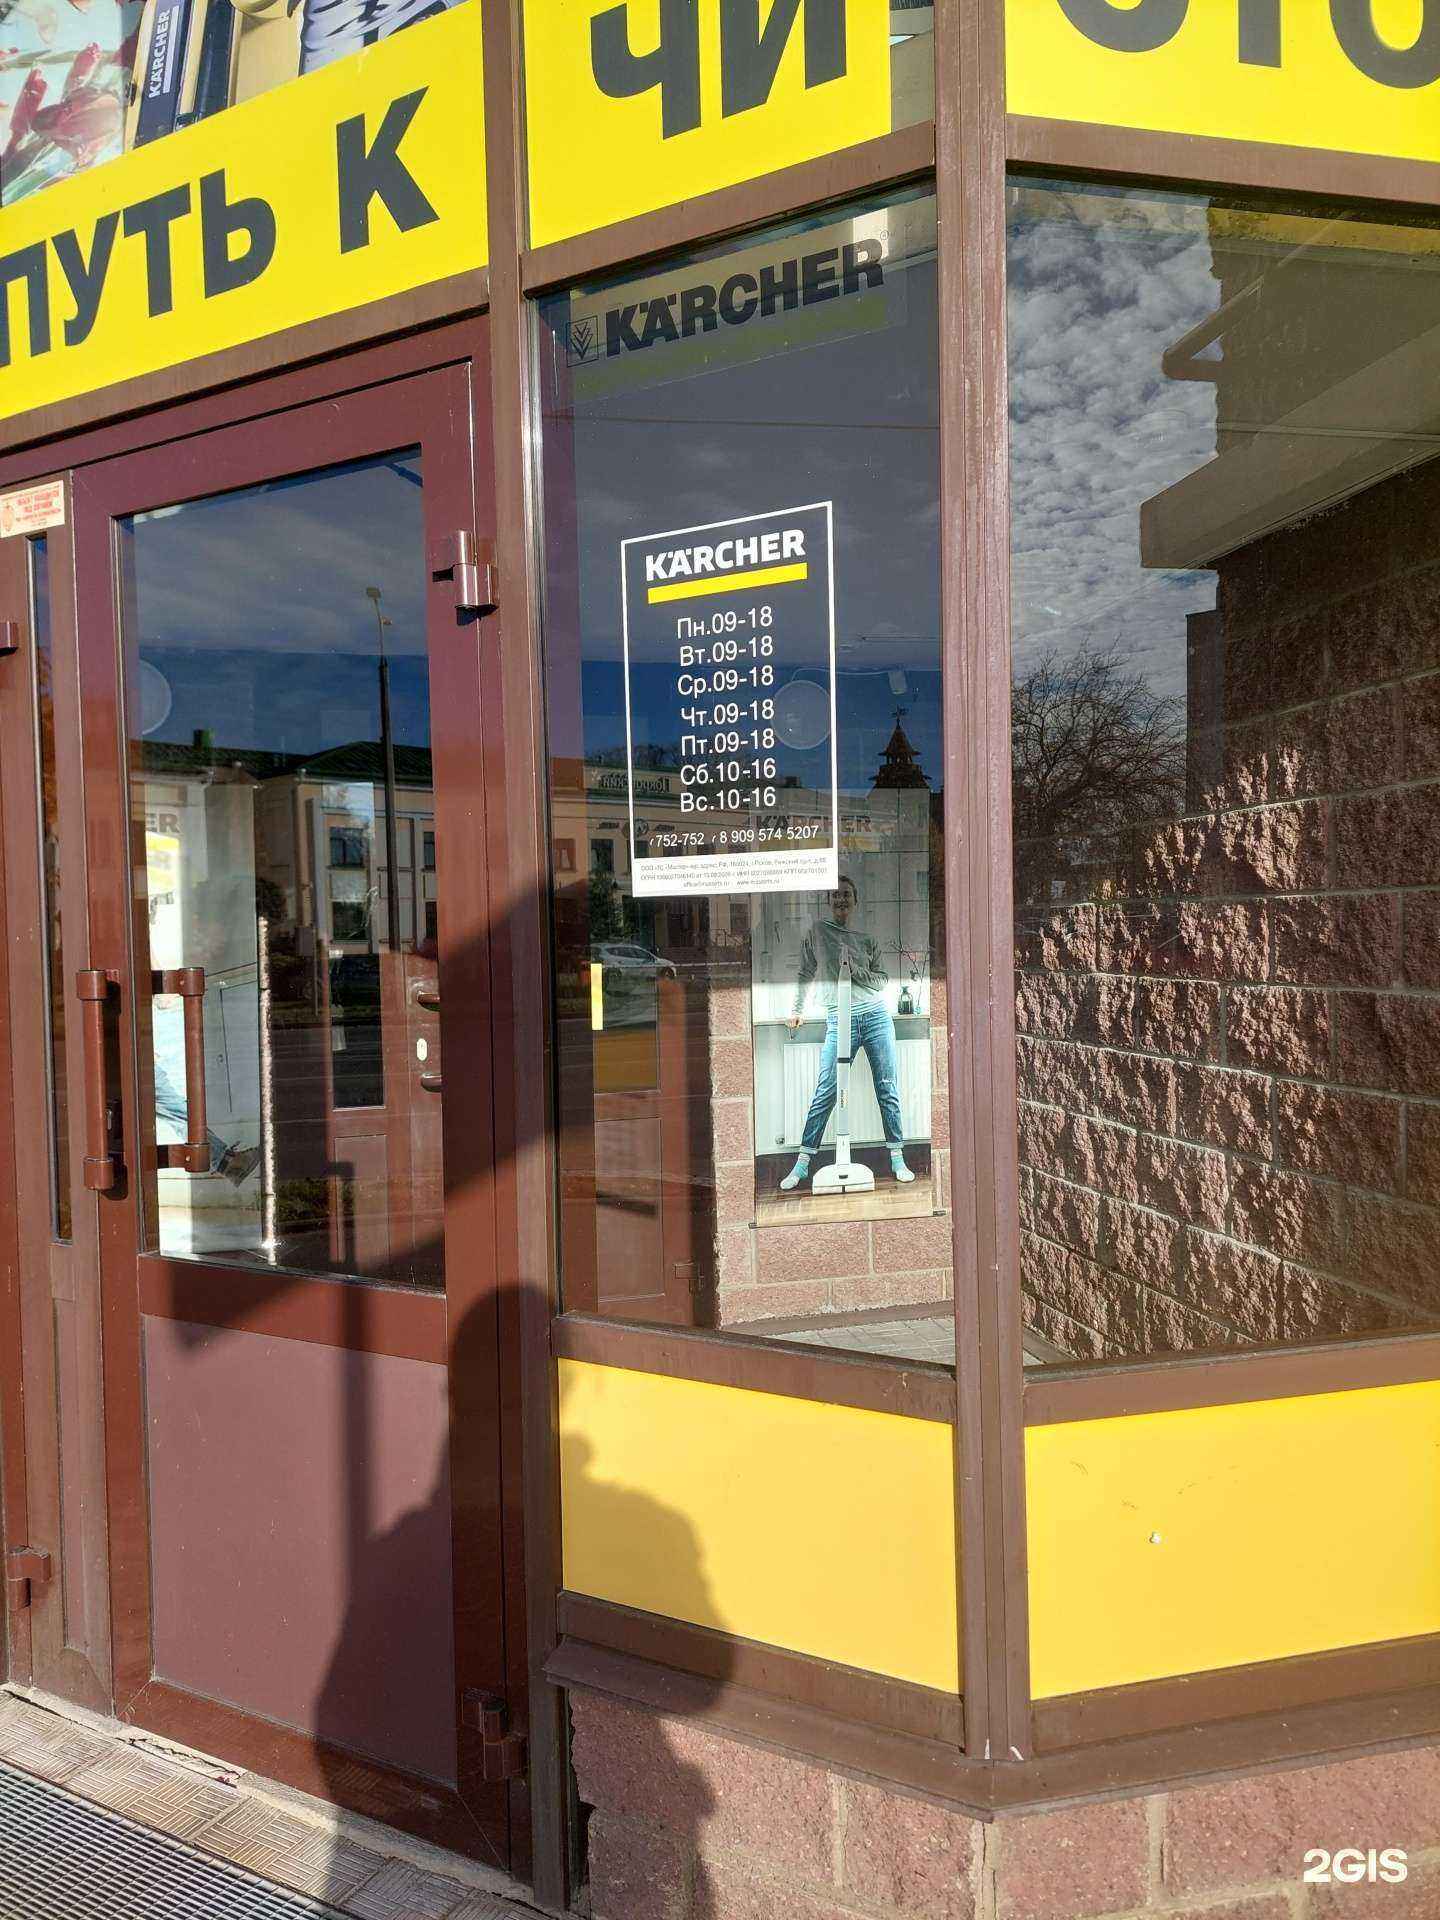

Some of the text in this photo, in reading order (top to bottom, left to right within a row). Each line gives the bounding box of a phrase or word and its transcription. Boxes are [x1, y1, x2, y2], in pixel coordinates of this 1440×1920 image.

[147, 7, 171, 98] KÄRCHER
[0, 169, 277, 367] ПУТЬ
[336, 86, 439, 254] К
[605, 238, 885, 357] KÄRCHER
[645, 529, 806, 582] KÄRCHER
[677, 605, 773, 639] Пн.09-18
[680, 635, 773, 667] Вт.09-18
[677, 665, 774, 699] Ср.09-18
[681, 699, 775, 727] Чт.09-18
[681, 728, 775, 756] Пт.09-18
[680, 757, 776, 785] Сб.10-16
[680, 786, 776, 813] Вс.10-16
[655, 825, 819, 848] 752-752 8 909 574 5207
